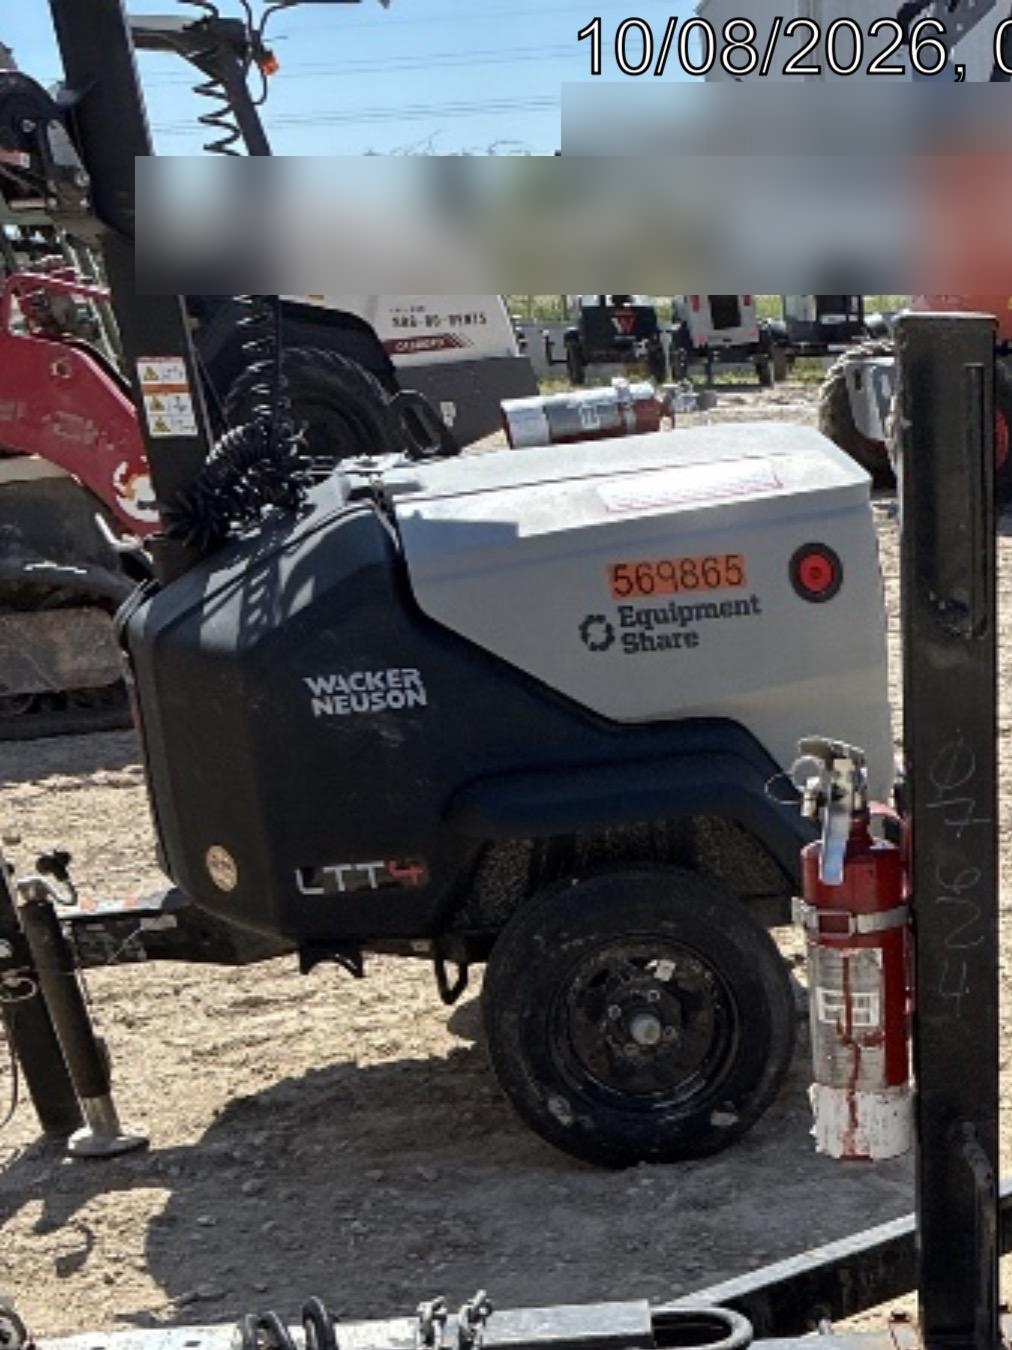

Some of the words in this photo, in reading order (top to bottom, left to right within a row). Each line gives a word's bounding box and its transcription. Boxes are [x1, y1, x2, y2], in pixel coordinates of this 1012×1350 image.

[613, 554, 744, 596] 569865
[617, 594, 762, 630] Equipment
[621, 630, 699, 654] Share
[302, 668, 423, 697] WACKER
[311, 686, 428, 718] NEUSON
[295, 860, 424, 896] LTT4
